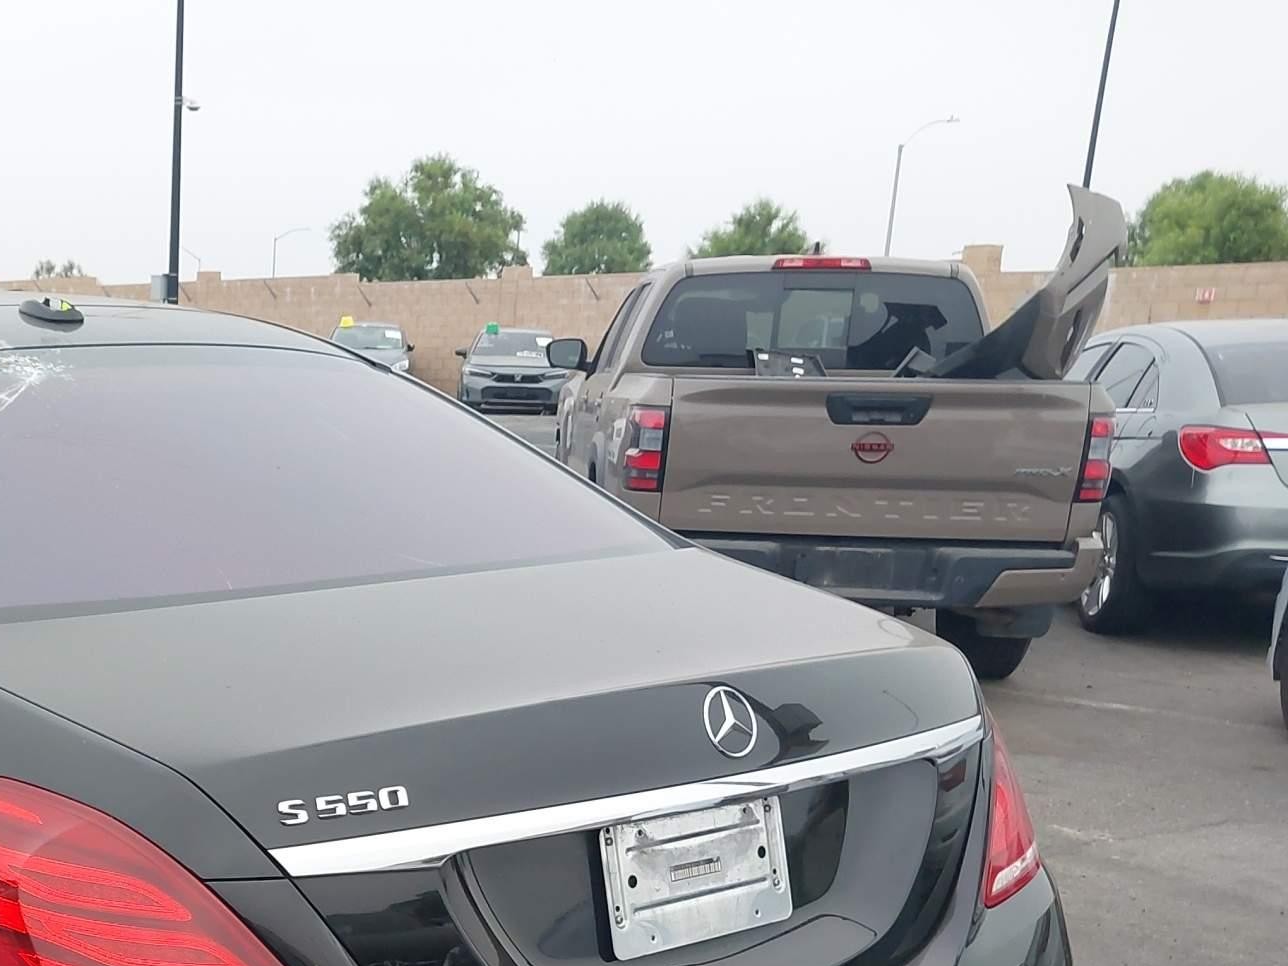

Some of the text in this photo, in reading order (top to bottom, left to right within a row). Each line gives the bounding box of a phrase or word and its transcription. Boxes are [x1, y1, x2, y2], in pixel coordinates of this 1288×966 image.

[697, 494, 1031, 521] FRONTIER
[278, 785, 409, 826] S 550
